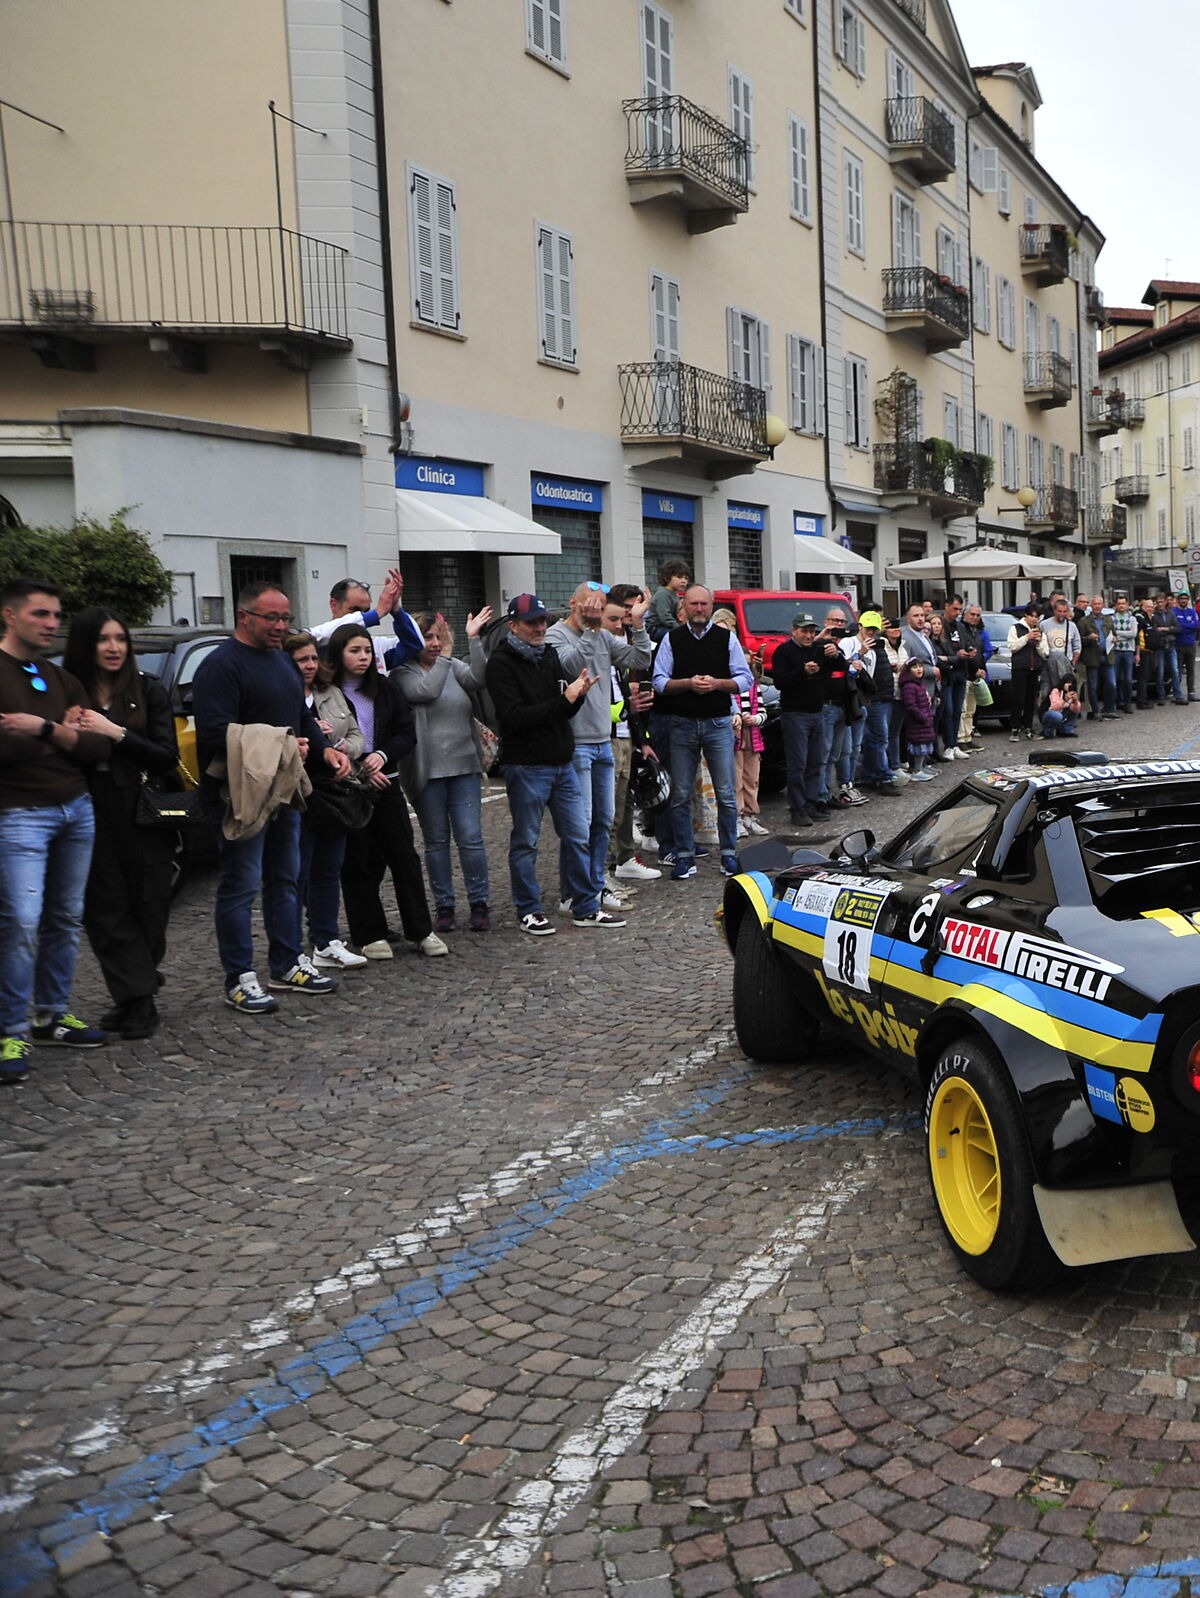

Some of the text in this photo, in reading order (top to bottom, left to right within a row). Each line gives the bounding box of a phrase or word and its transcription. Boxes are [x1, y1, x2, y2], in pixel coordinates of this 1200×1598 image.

[416, 465, 456, 486] Clinica
[535, 482, 593, 503] Odontoiatrica
[658, 500, 674, 514] Villa
[311, 569, 320, 580] 12
[1028, 764, 1147, 788] LANCIA
[837, 930, 857, 984] 18
[944, 920, 1126, 1001] TOTAL PIRELLI
[813, 968, 854, 1024] le
[953, 1054, 970, 1073] P7
[1087, 1084, 1115, 1103] BILSTEIN
